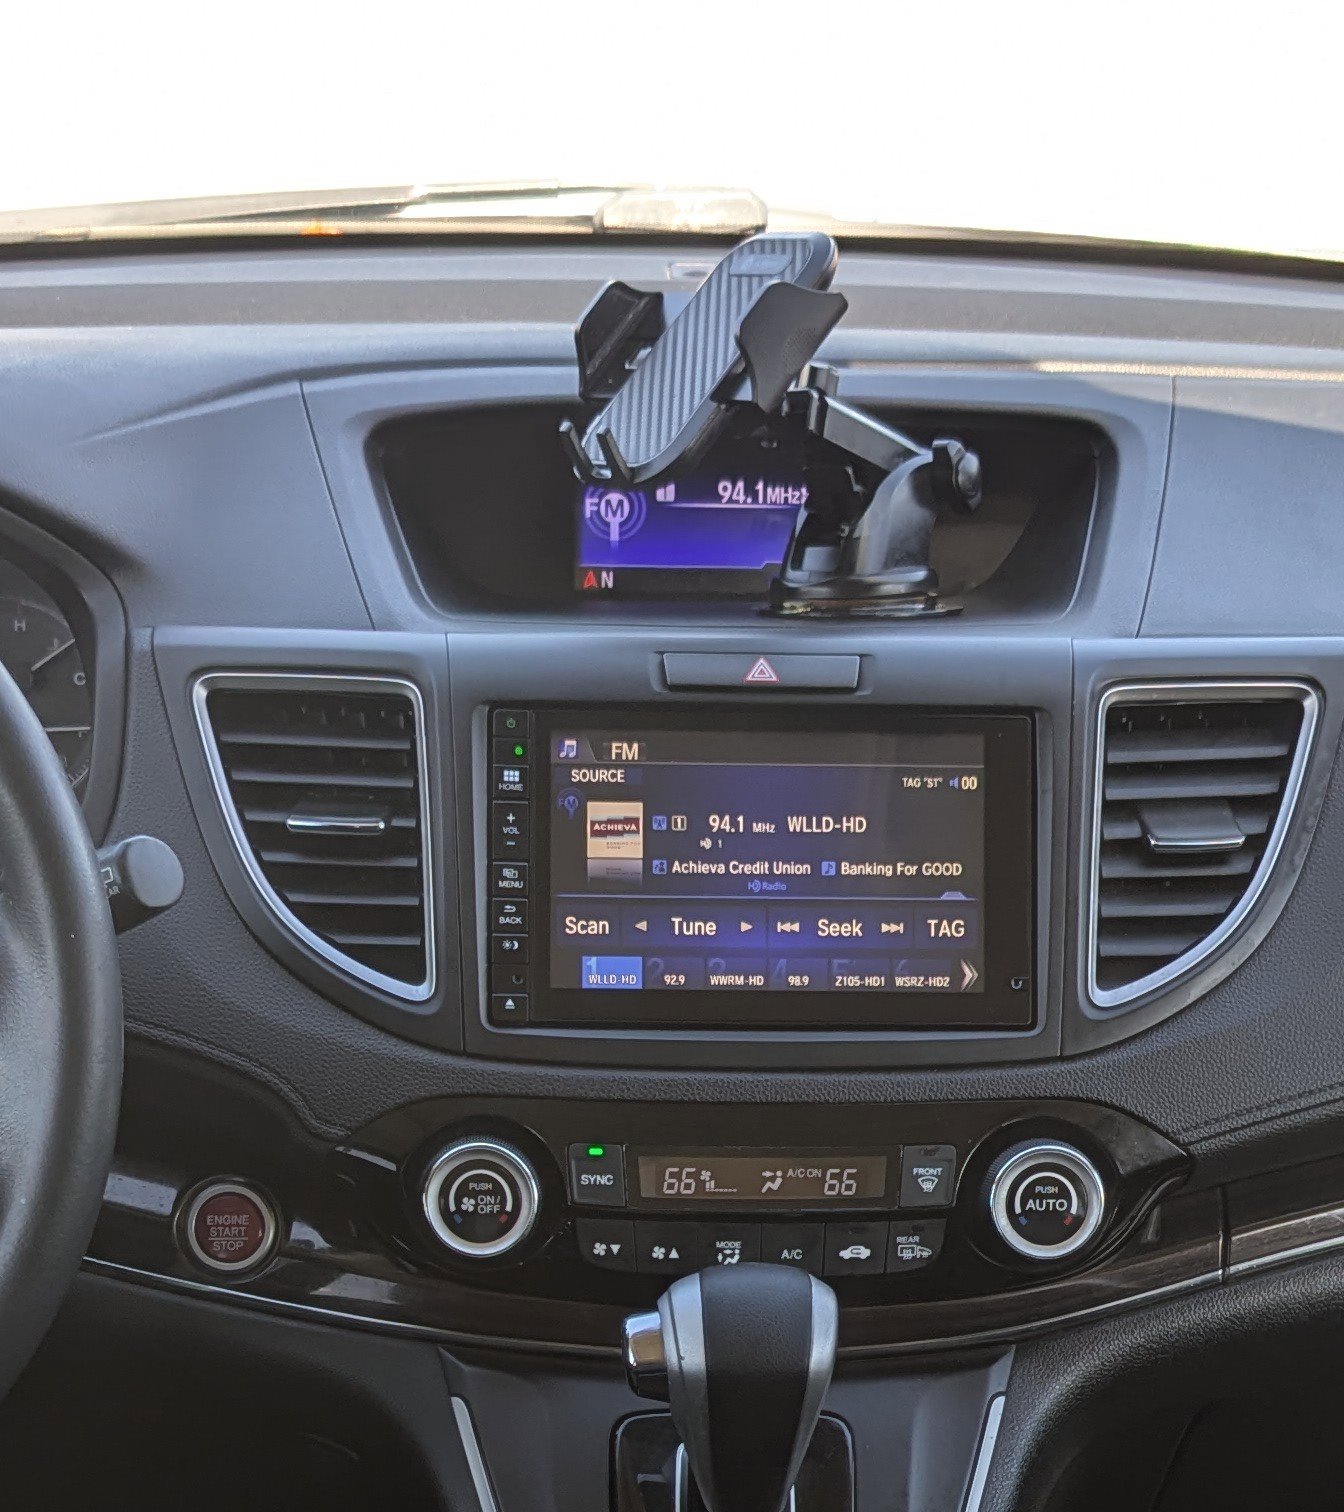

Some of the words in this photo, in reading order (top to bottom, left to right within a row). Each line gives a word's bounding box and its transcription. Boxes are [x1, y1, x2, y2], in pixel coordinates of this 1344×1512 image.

[600, 572, 614, 589] N
[14, 618, 26, 632] H
[73, 672, 87, 686] C
[611, 742, 639, 761] FM
[571, 769, 626, 783] SOURCE
[498, 783, 524, 792] HOME
[961, 776, 979, 790] 00
[593, 822, 638, 832] ACHIEVA
[709, 814, 745, 833] 94.1
[787, 815, 867, 834] WLLD-HD
[672, 860, 726, 875] Achieva
[729, 860, 770, 875] Credit
[773, 861, 811, 875] Union
[841, 861, 893, 877] Banking
[896, 862, 918, 876] For
[922, 862, 963, 877] GOOD
[498, 916, 523, 925] BACK
[565, 916, 610, 935] Scan
[671, 917, 717, 936] Tune
[817, 918, 863, 937] Seek
[927, 919, 966, 938] TAG
[663, 974, 686, 986] 92.9
[787, 1168, 806, 1178] A/C
[807, 1168, 823, 1179] ON
[912, 1167, 944, 1176] FRONT
[468, 1182, 493, 1191] PUSH
[580, 1174, 614, 1186] SYNC
[662, 1167, 697, 1195] 66
[823, 1168, 858, 1196] 66
[1035, 1185, 1059, 1194] PUSH
[477, 1204, 501, 1214] OFF
[1025, 1198, 1068, 1212] AUTO
[206, 1214, 250, 1226] ENGINE
[209, 1226, 247, 1237] START
[213, 1240, 244, 1251] STOP
[716, 1240, 742, 1249] MODE
[896, 1235, 920, 1244] REAR
[781, 1249, 803, 1260] A/C
